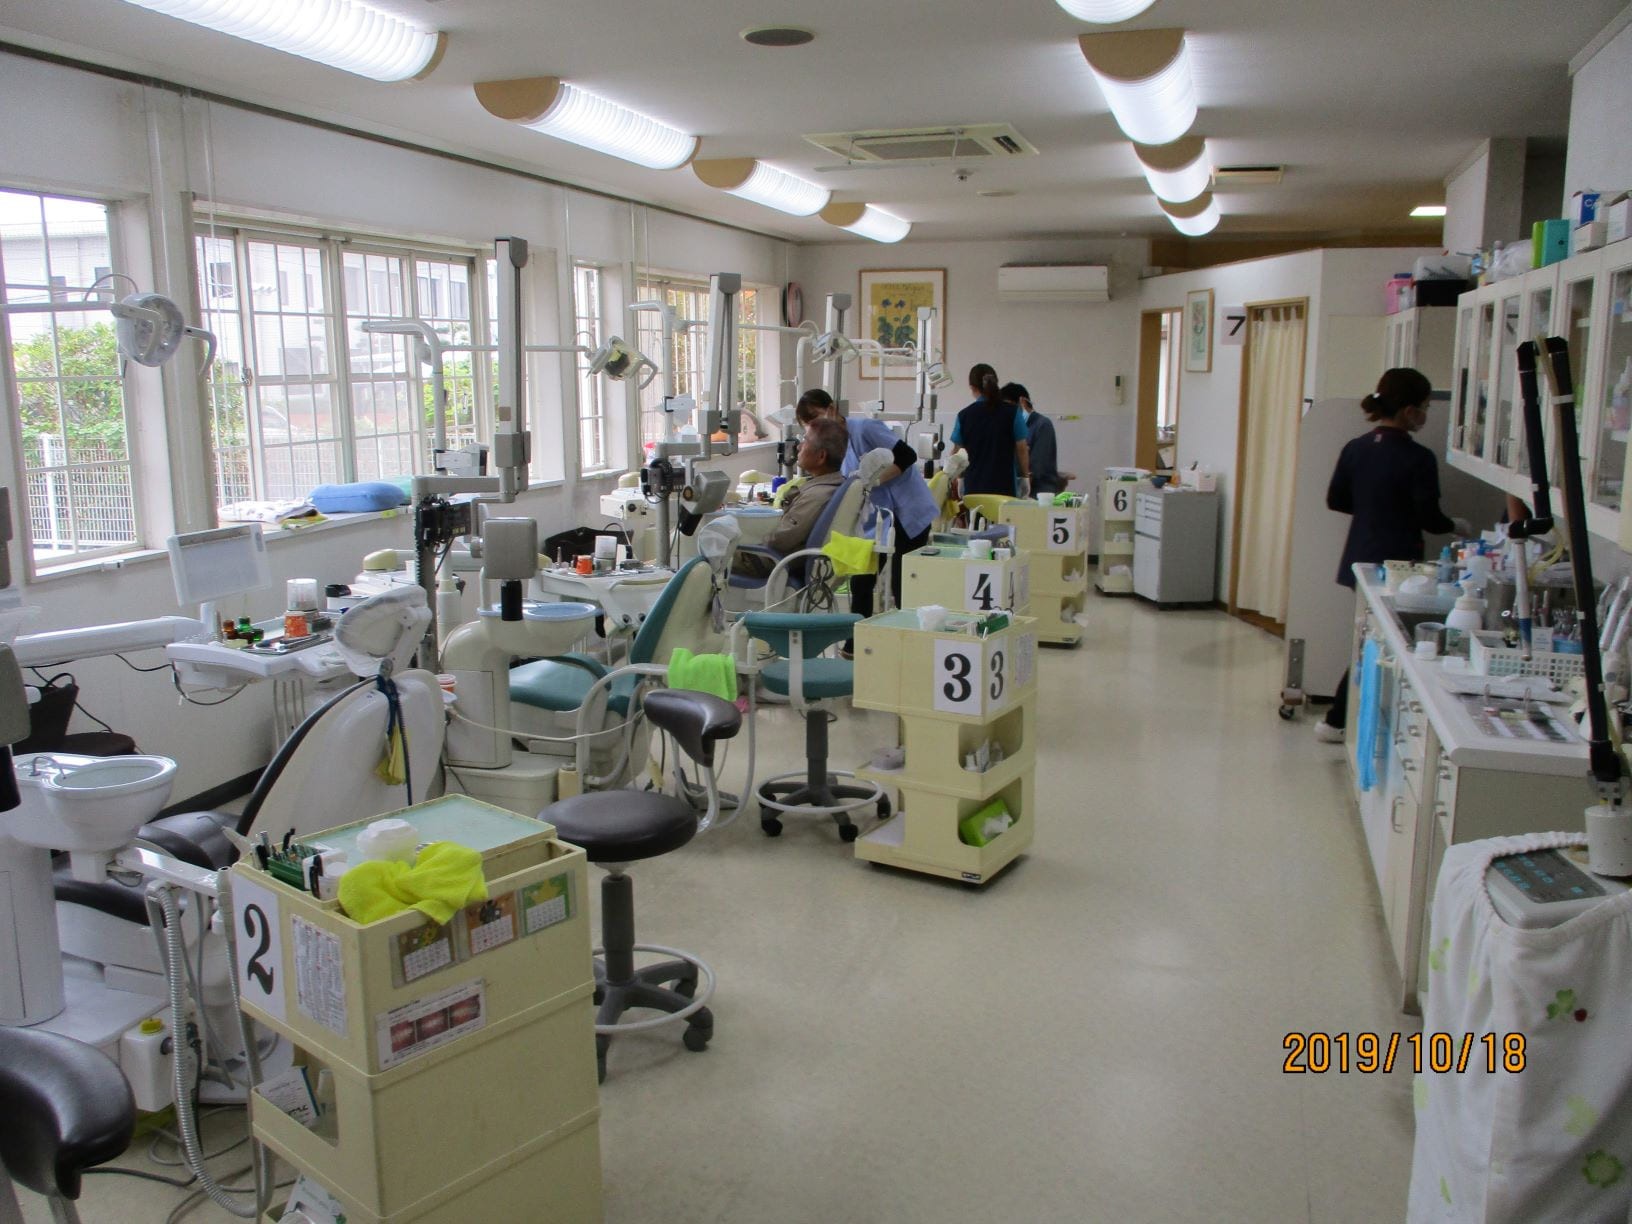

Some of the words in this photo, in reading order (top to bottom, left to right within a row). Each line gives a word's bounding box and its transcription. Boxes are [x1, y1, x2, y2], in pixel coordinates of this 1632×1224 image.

[1226, 315, 1247, 337] 7
[1113, 489, 1127, 512] 6
[1053, 517, 1069, 545] 5
[972, 573, 994, 611] 4
[943, 653, 972, 702] 3
[990, 651, 1004, 700] 3
[244, 903, 274, 995] 2
